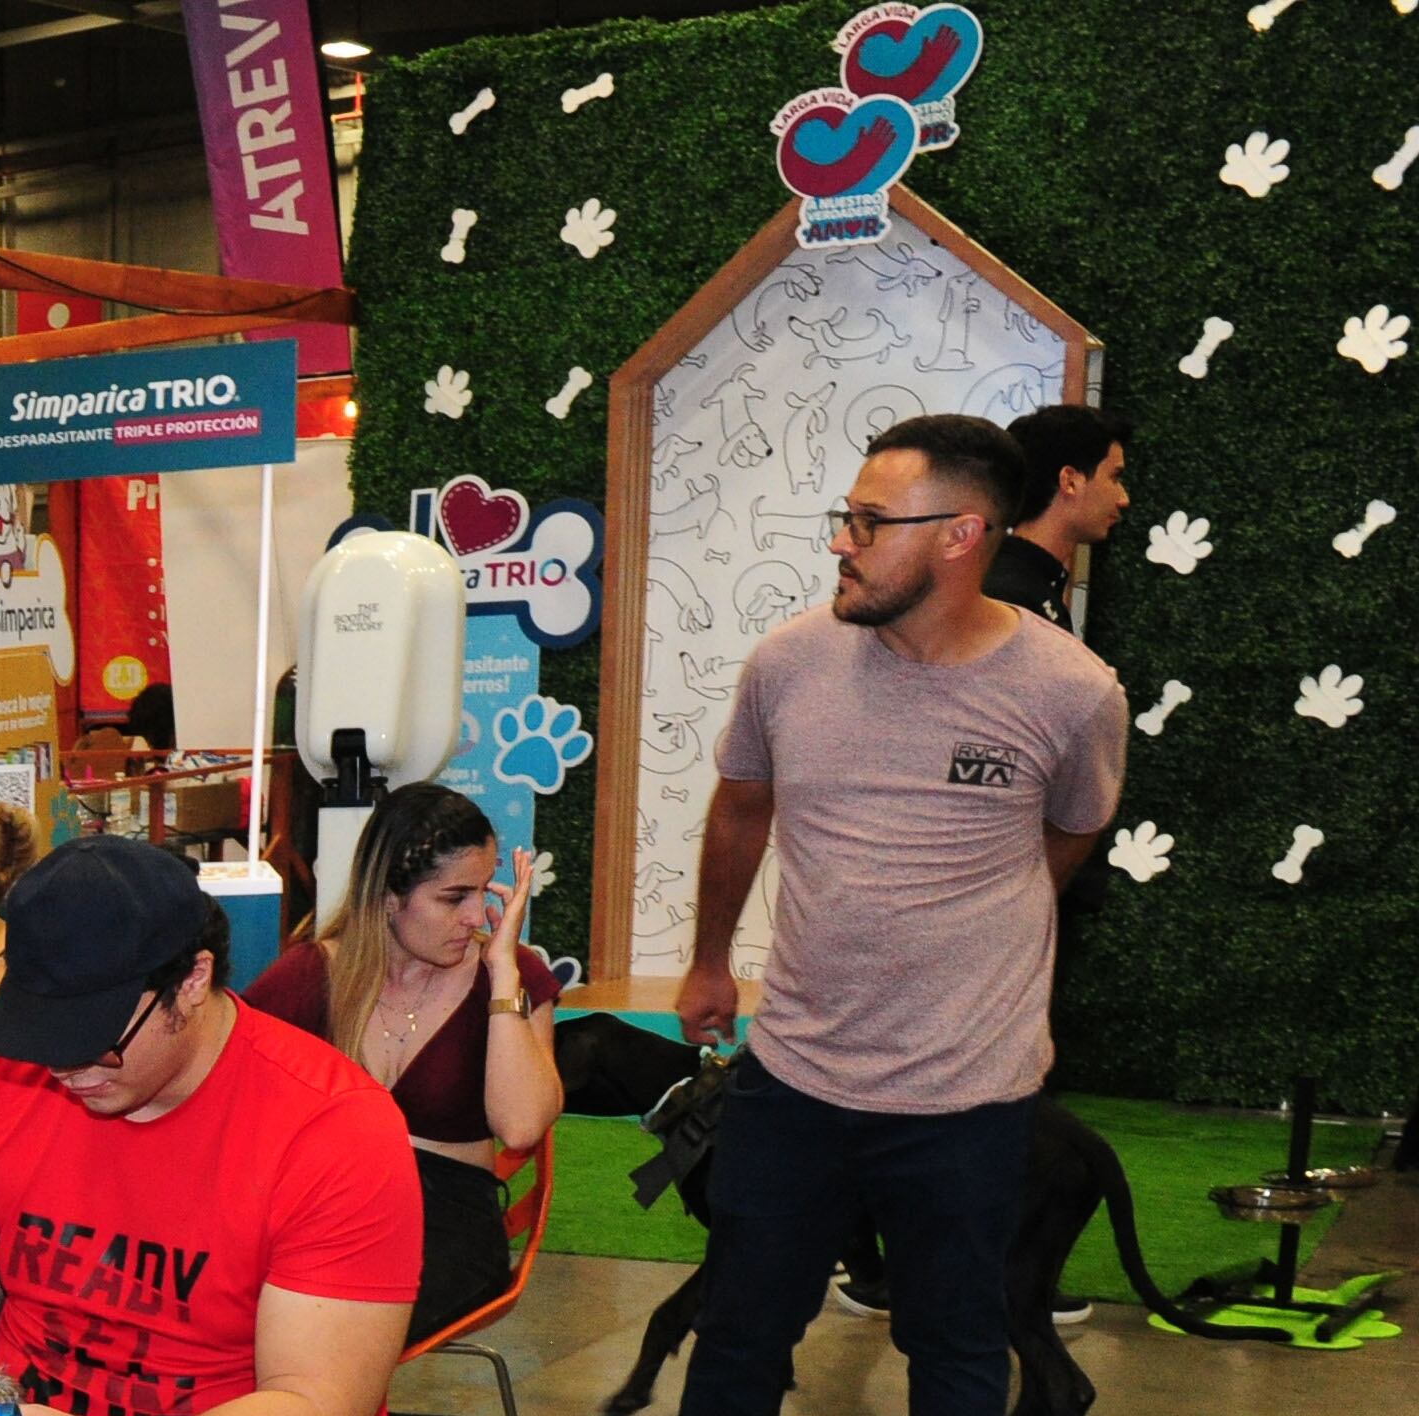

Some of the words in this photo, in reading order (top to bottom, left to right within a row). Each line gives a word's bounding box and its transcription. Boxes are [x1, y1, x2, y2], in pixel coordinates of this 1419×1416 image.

[839, 10, 881, 48] LARGA
[219, 0, 310, 235] ATREV
[776, 96, 818, 130] LARGA
[10, 384, 147, 424] Simparica
[148, 374, 237, 409] TRIO
[115, 422, 164, 439] TRIPLE
[166, 413, 259, 436] PROTECCIÓN
[485, 557, 567, 587] TRIO
[464, 656, 530, 673] asitante
[463, 674, 511, 693] erros!
[958, 744, 1012, 762] RVCA
[7, 1212, 210, 1323] READY
